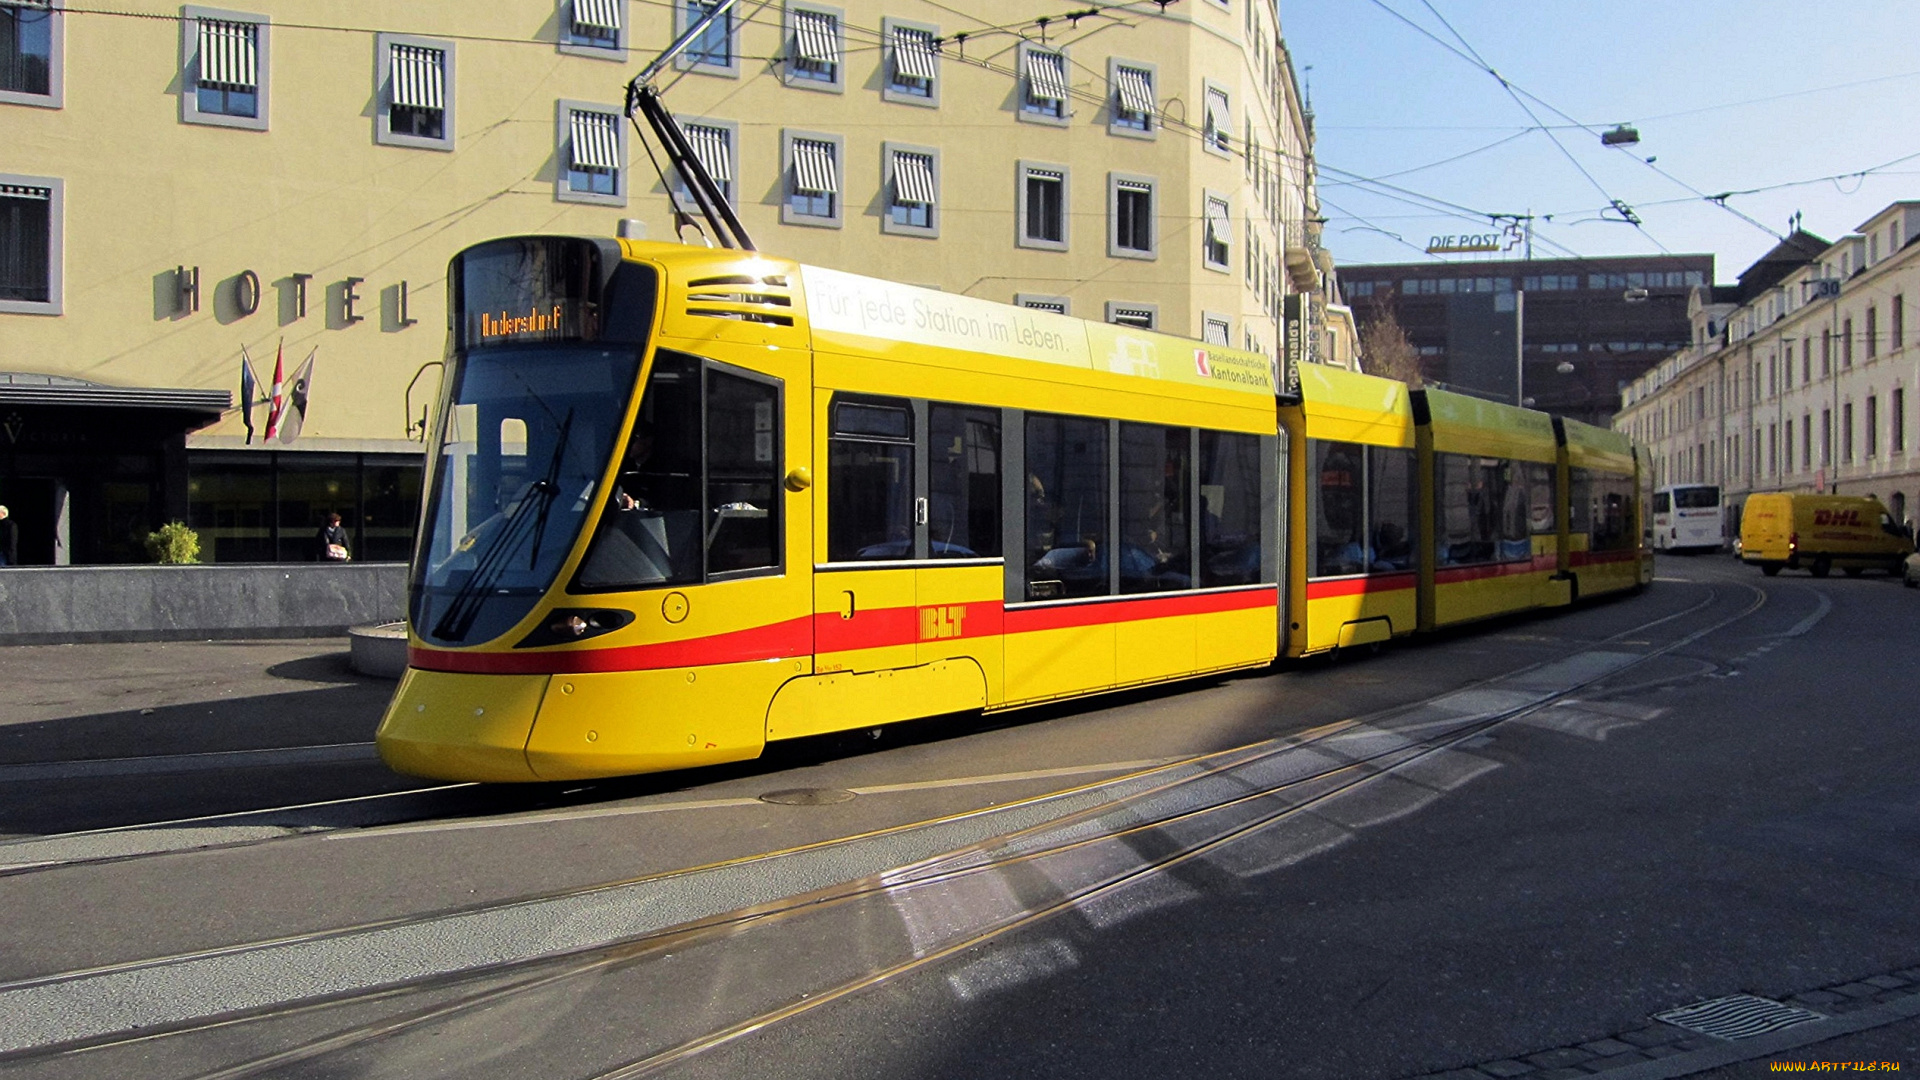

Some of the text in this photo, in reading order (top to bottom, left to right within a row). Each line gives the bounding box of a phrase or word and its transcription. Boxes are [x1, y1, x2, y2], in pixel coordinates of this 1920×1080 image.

[1429, 233, 1501, 248] DIE POST
[177, 265, 418, 325] HOTEL
[1820, 281, 1839, 295] 30
[814, 279, 1070, 352] Für jede Station im Leben.
[1210, 364, 1269, 387] Kantonalbank
[1814, 509, 1862, 527] DHL
[920, 606, 967, 639] BLT
